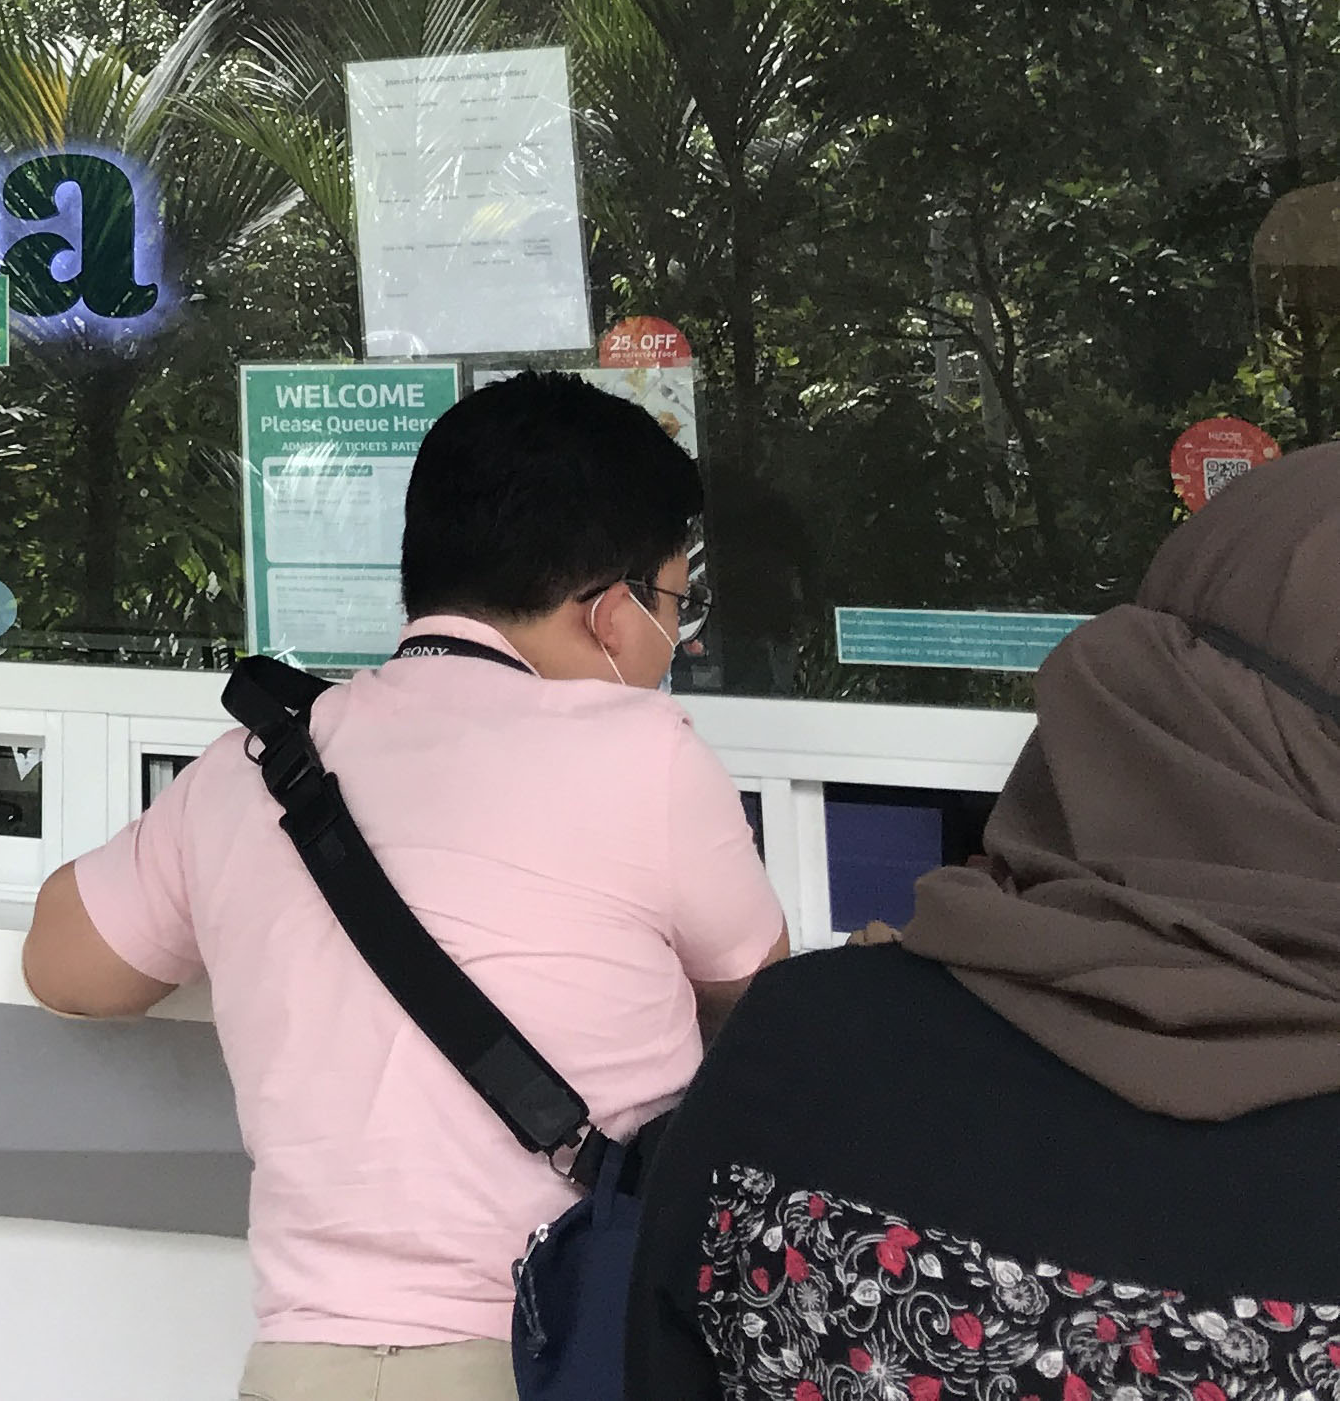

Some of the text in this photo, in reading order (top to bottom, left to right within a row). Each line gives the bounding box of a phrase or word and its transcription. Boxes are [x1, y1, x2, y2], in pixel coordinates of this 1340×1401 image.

[641, 334, 677, 350] OFF
[275, 383, 425, 409] WELCOME
[260, 415, 322, 432] Please
[327, 415, 389, 434] Queue
[344, 441, 387, 452] TICKETS
[391, 441, 422, 452] RATE
[401, 646, 450, 657] SONY
